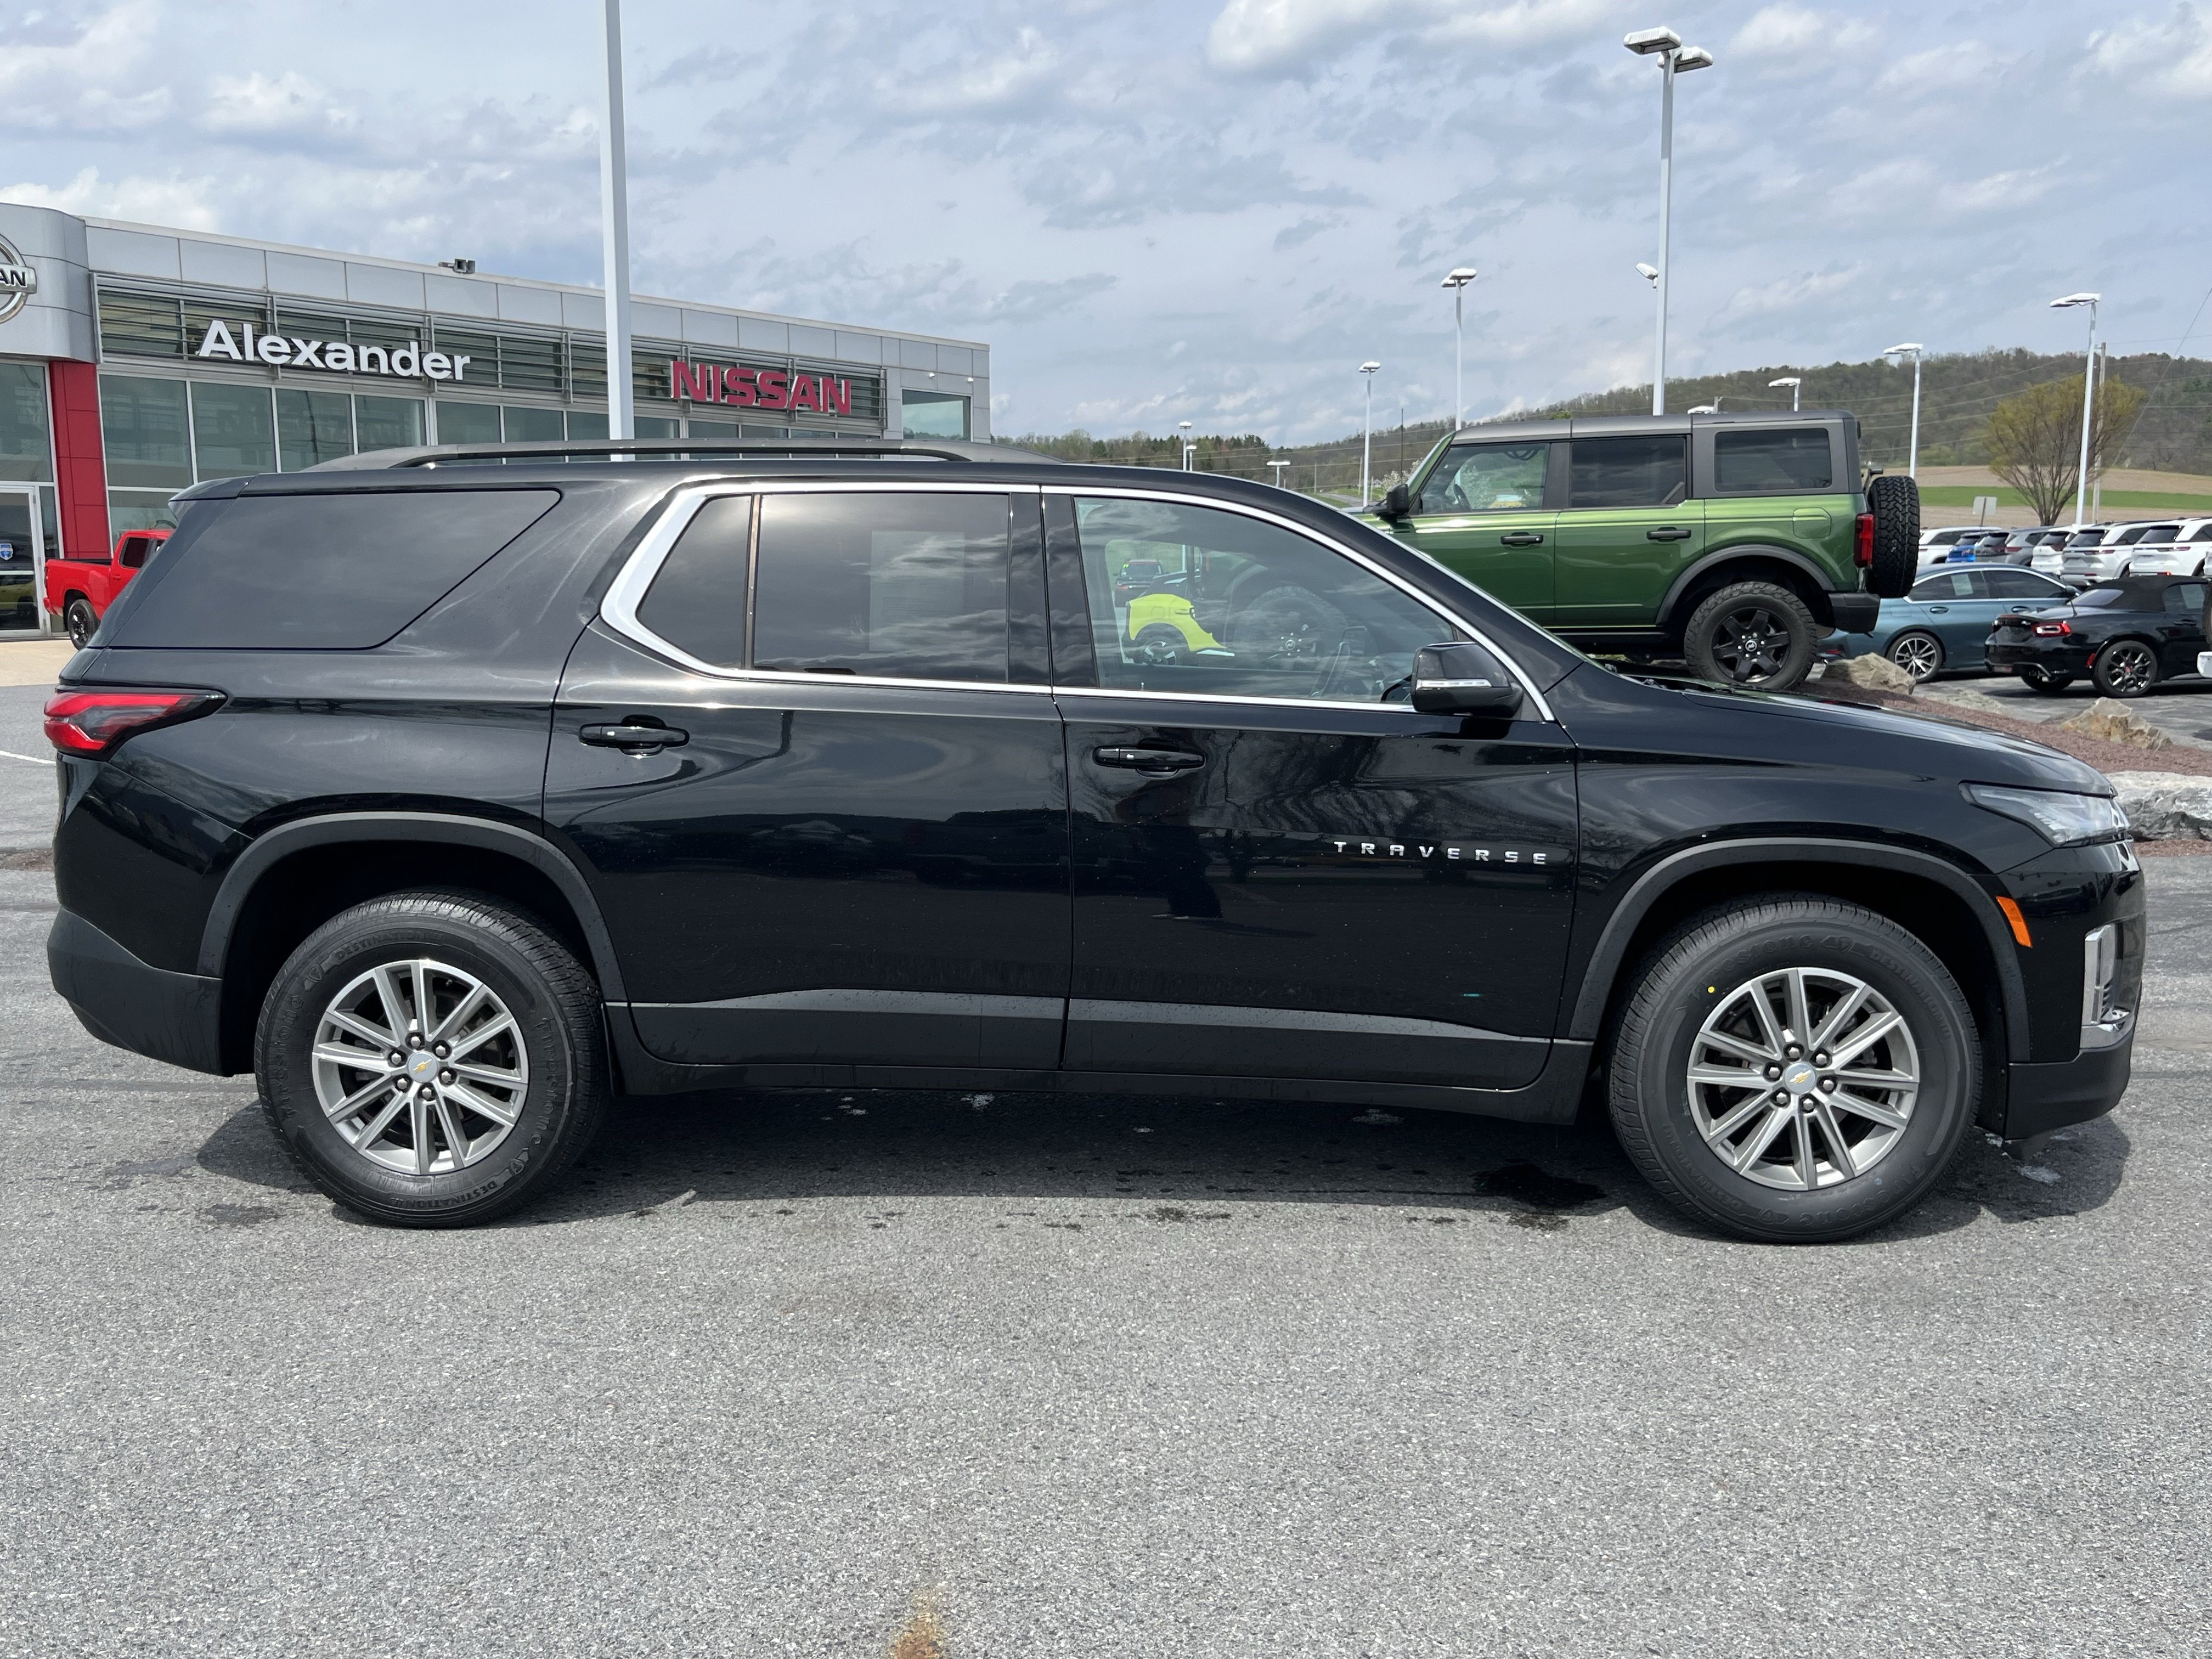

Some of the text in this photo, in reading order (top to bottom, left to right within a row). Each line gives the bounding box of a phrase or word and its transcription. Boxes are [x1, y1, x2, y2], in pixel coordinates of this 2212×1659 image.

[197, 320, 471, 381] Alexander
[670, 360, 851, 415] NISSAN
[1334, 841, 1547, 865] TRAVERSE
[405, 1180, 498, 1208] DESTINATION
